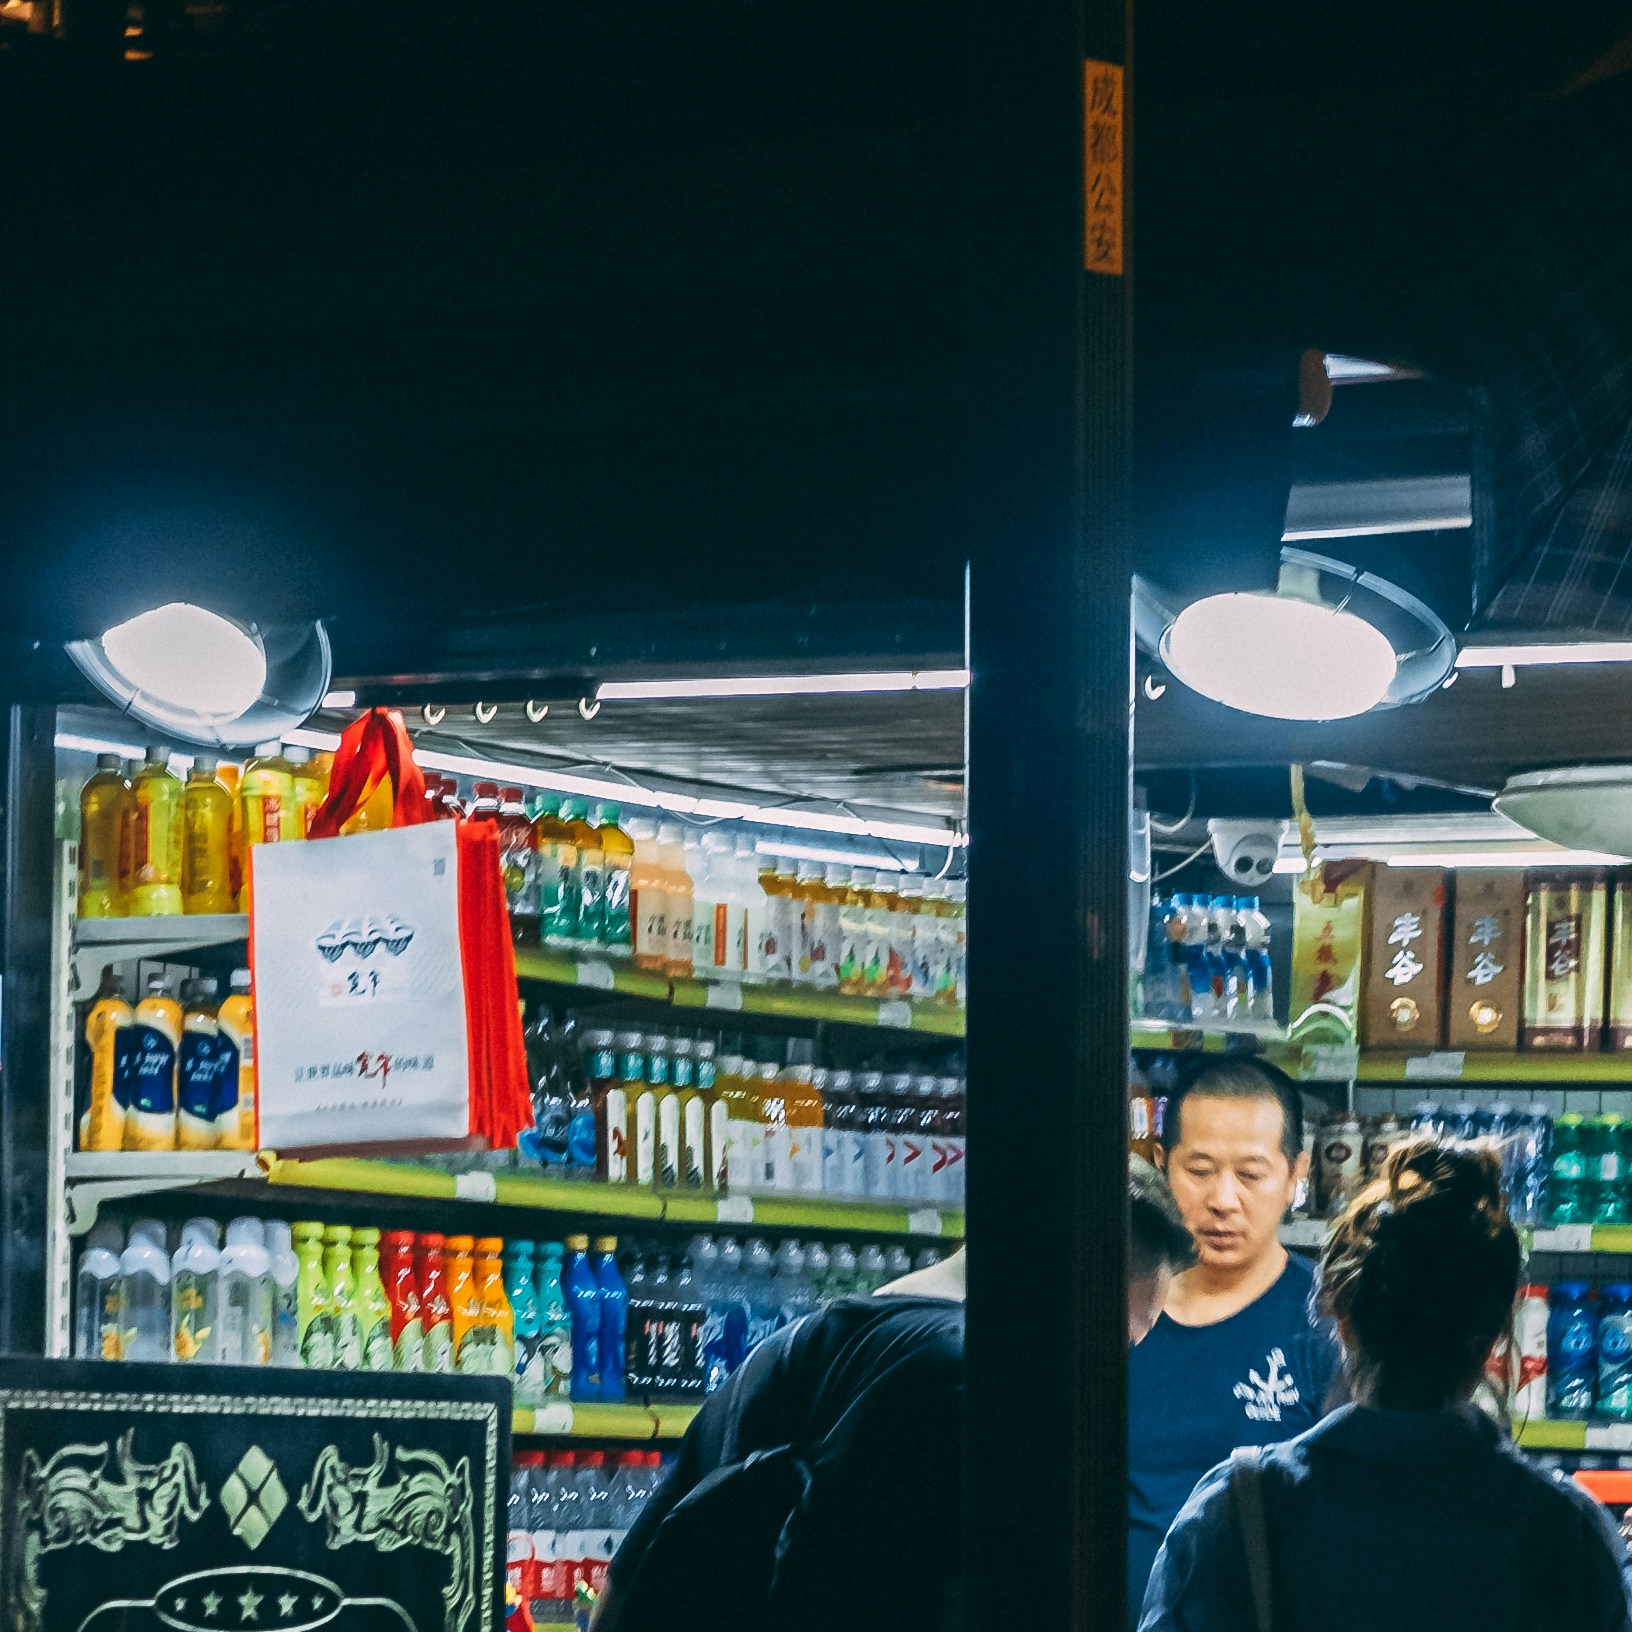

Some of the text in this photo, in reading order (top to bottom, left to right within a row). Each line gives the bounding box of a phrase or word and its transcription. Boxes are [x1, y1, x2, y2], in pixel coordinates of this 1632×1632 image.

[1088, 70, 1118, 266] 成都公安
[1385, 912, 1423, 985] 丰谷
[1467, 914, 1504, 986] 丰谷
